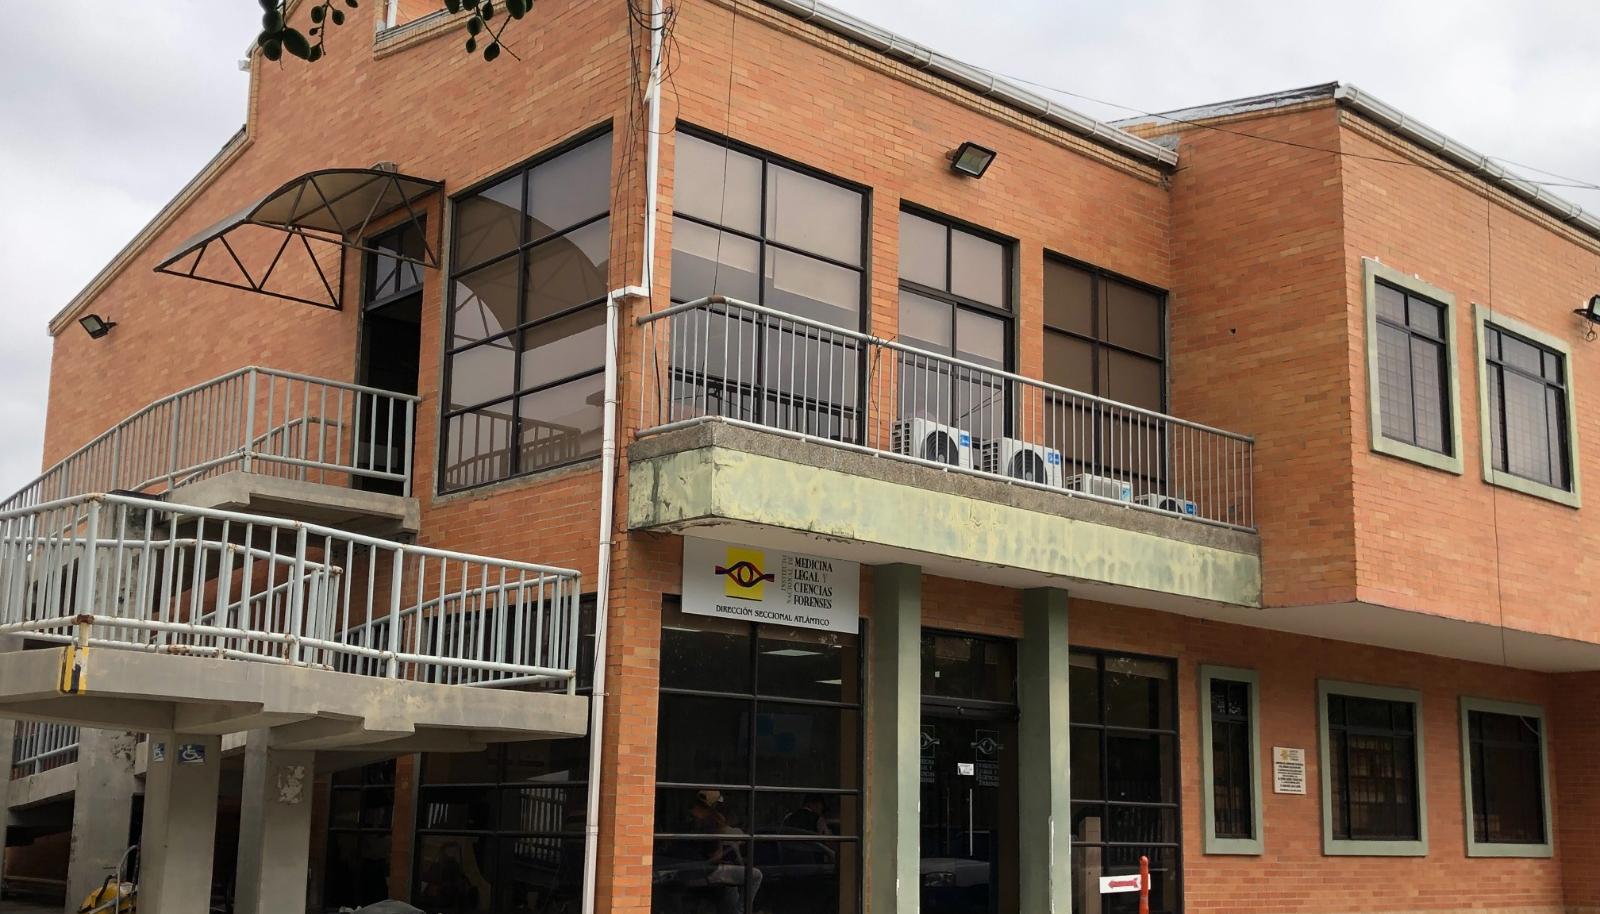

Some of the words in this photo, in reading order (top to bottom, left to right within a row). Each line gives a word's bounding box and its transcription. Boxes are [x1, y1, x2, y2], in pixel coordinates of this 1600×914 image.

[795, 557, 833, 572] MEDICINA
[794, 569, 820, 583] LEGAL
[822, 573, 828, 583] Y
[794, 582, 833, 597] CIENCIAS
[793, 595, 832, 609] FORENSES
[715, 605, 753, 616] DIRECCIÓN
[754, 610, 793, 621] SECCIONAL
[794, 615, 830, 626] ATLÁNTICO
